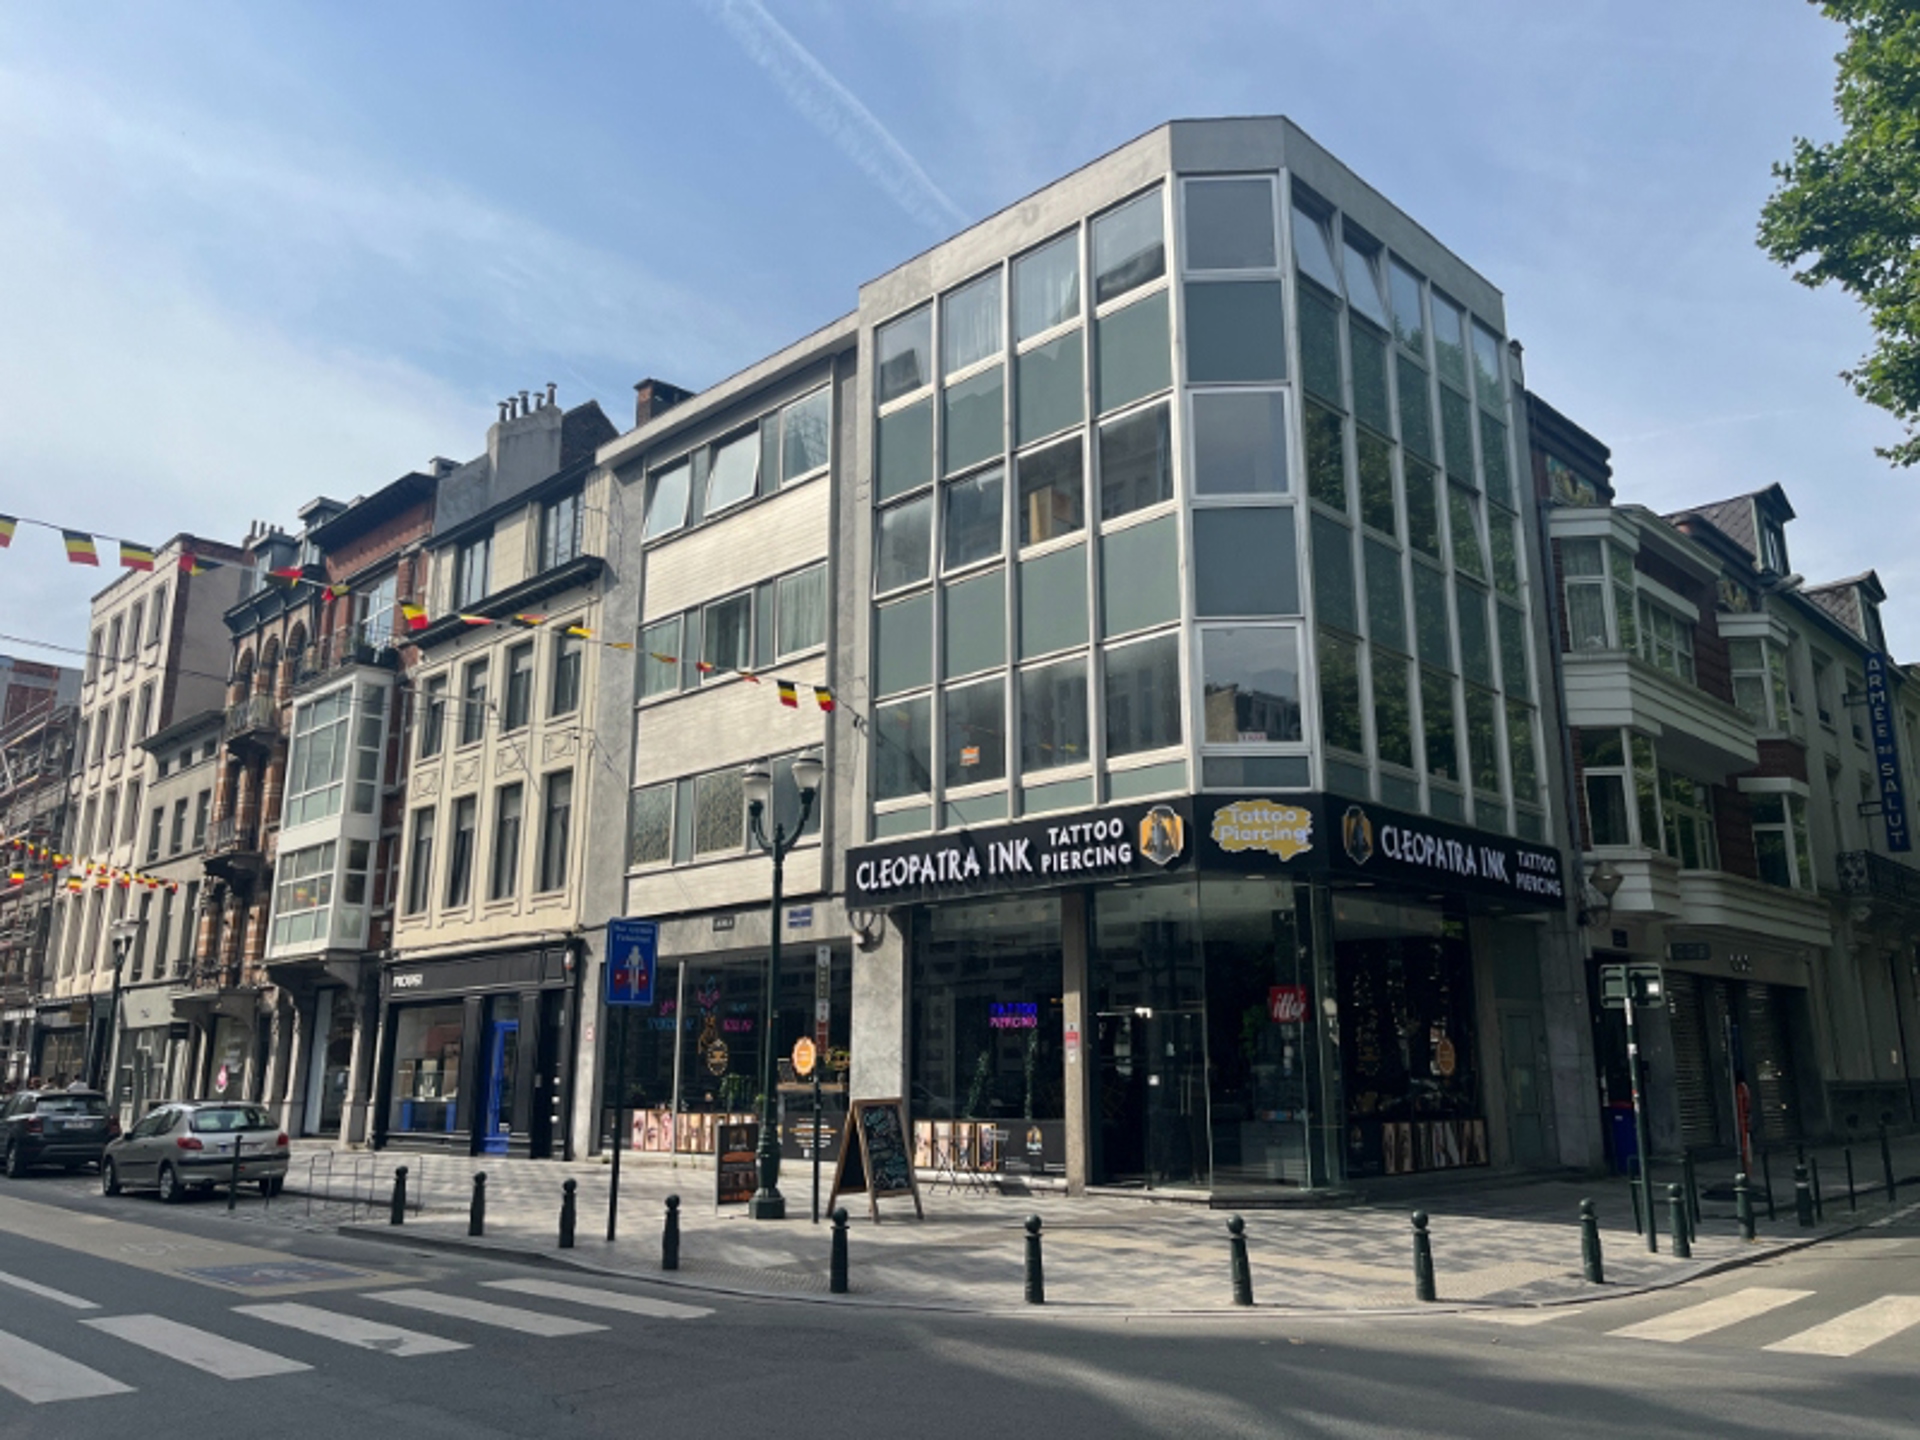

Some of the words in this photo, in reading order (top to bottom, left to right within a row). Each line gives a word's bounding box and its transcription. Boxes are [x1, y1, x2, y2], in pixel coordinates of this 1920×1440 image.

[1229, 806, 1297, 824] Tattoo
[1881, 763, 1904, 845] SALUT
[1048, 818, 1125, 847] TATTOO
[1219, 825, 1308, 845] Piercing
[856, 847, 980, 892] CLEOPATRA
[988, 838, 1033, 875] INK
[1041, 843, 1133, 874] PIERCING
[1381, 825, 1478, 877] CLEOPATRA
[1480, 847, 1510, 884] INK
[1516, 851, 1557, 875] TATTOO
[1516, 873, 1562, 897] PIERCING
[1273, 992, 1307, 1020] illy
